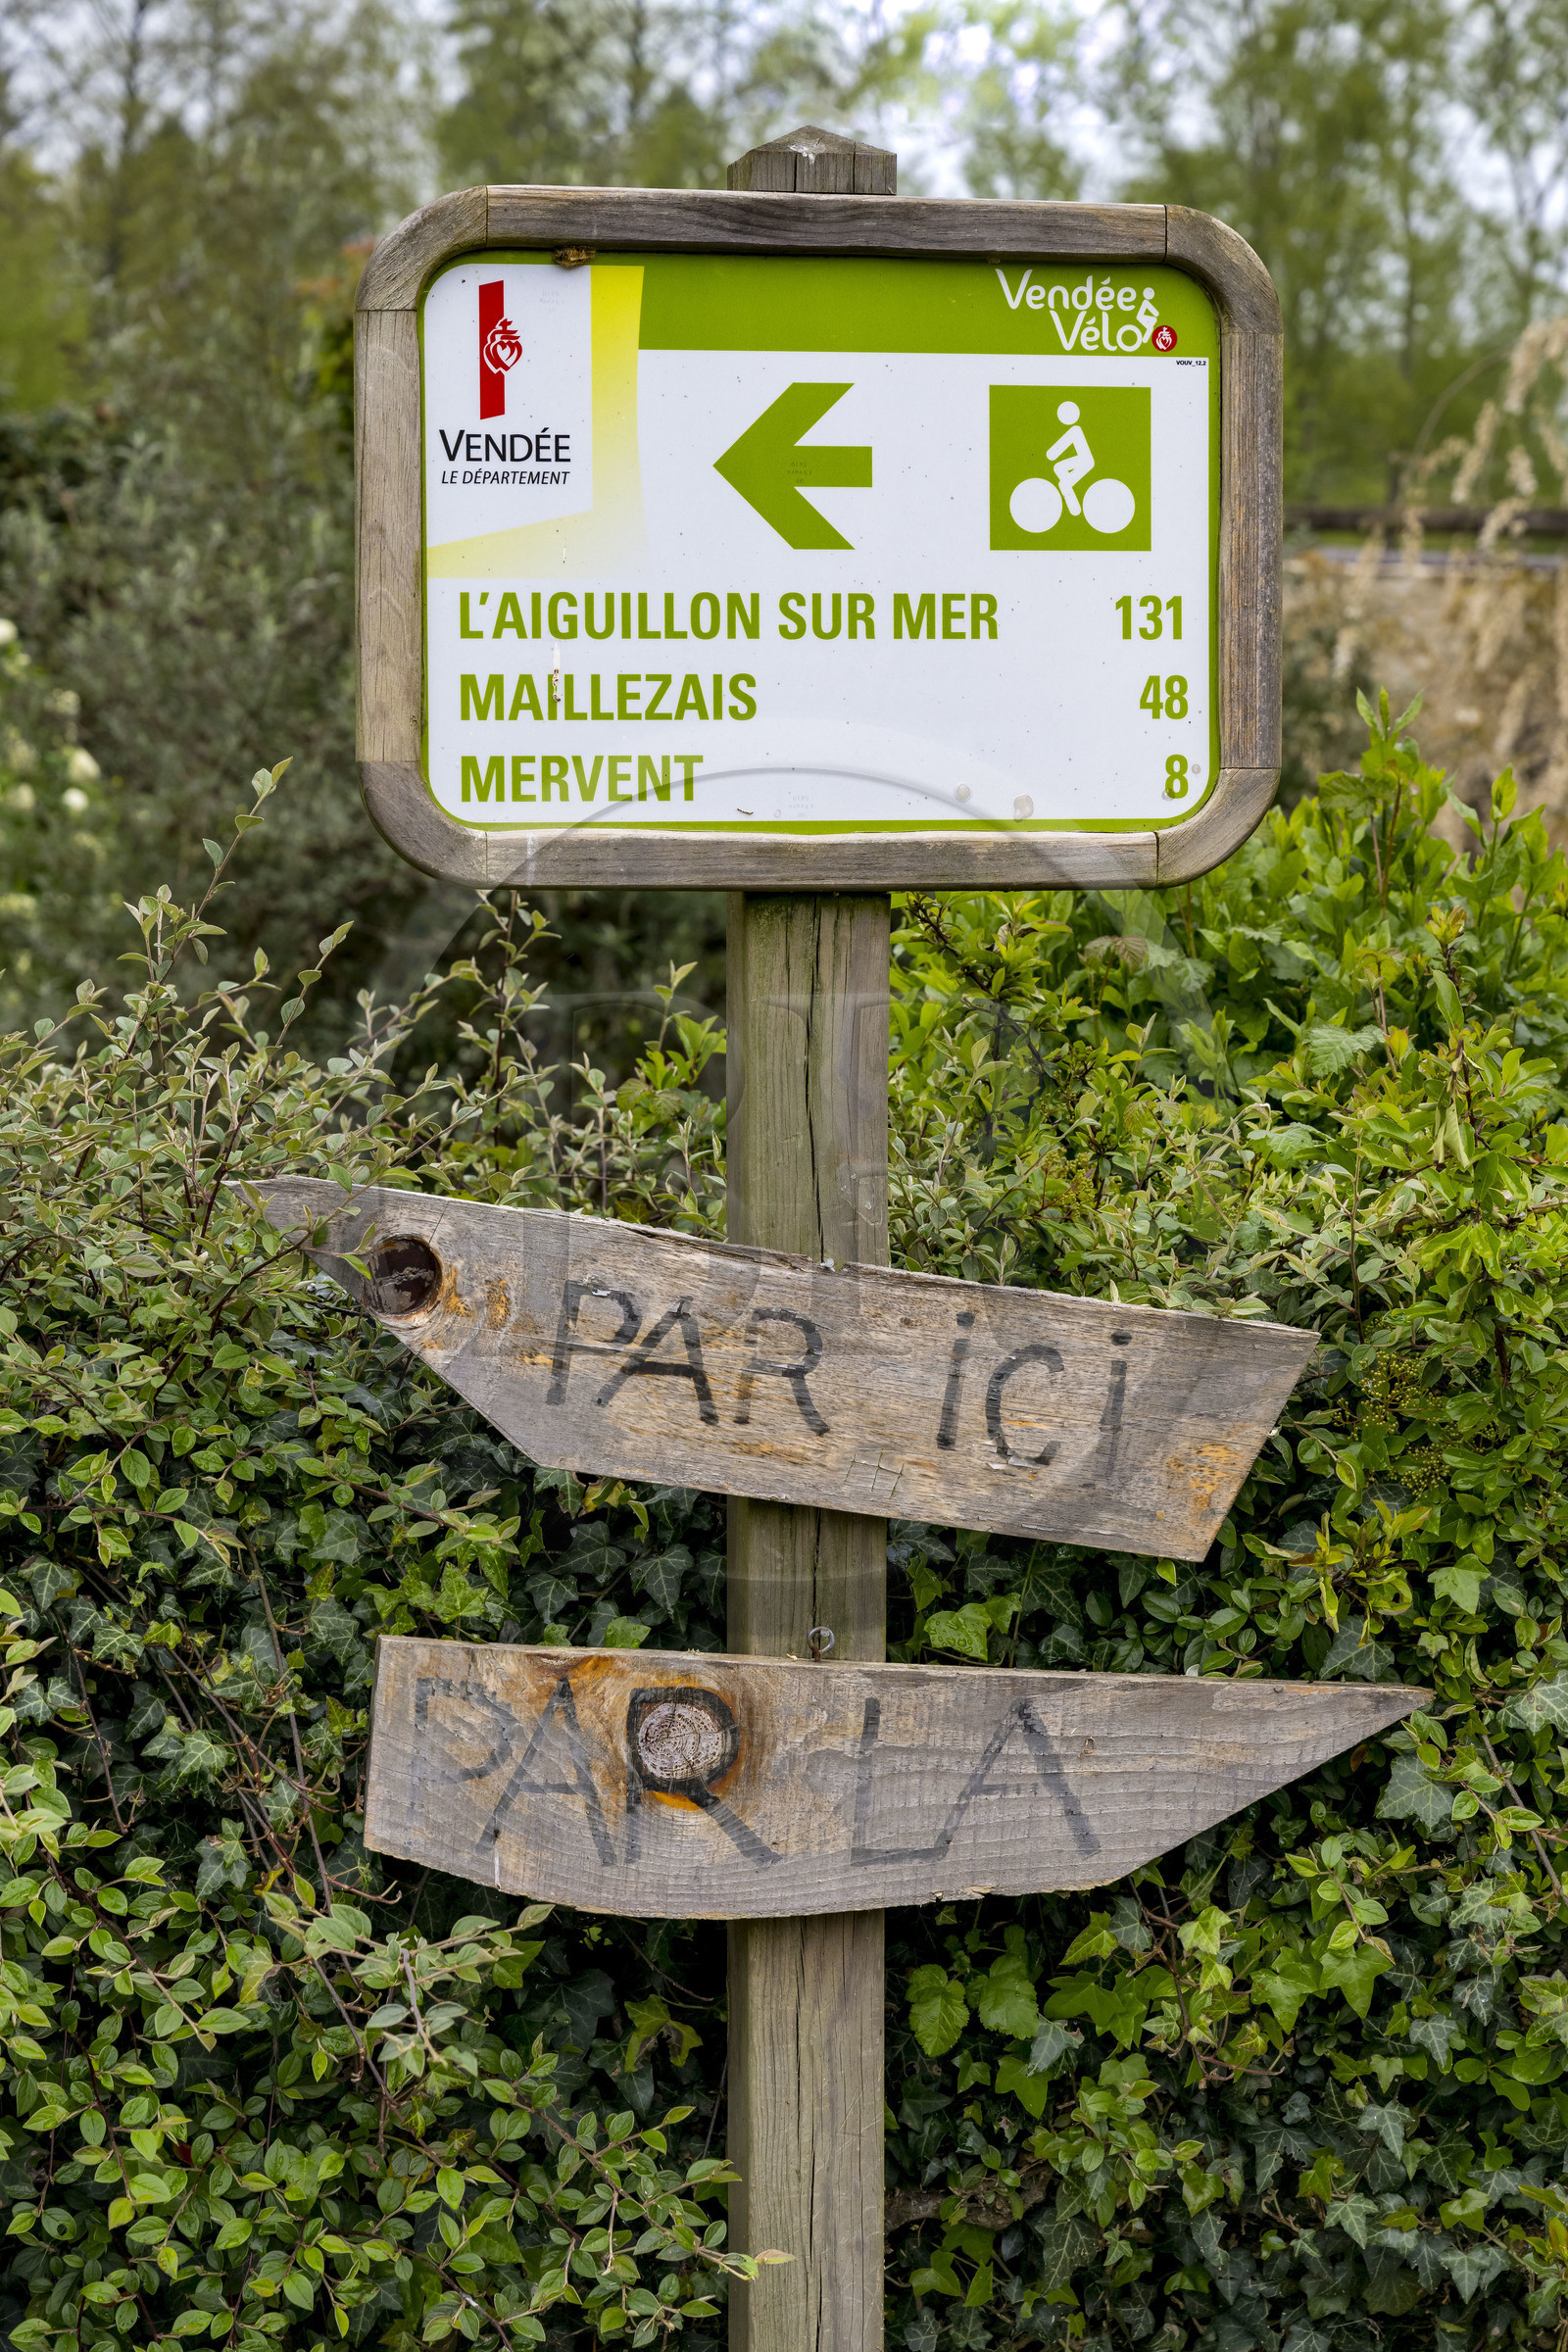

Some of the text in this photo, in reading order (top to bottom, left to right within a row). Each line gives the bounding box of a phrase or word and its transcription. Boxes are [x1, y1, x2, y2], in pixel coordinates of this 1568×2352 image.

[995, 269, 1137, 312] Vendée
[1049, 310, 1143, 352] Vélo
[438, 427, 571, 463] VENDÉE
[441, 468, 570, 485] LE DÉPARTEMENT
[459, 591, 999, 640] L'AIGUILLON SUR MER
[1114, 595, 1183, 640] 131
[460, 673, 758, 721] MAILLEZAIS
[1139, 674, 1189, 720] 48
[461, 755, 704, 803] MERVENT
[1165, 754, 1189, 800] 8
[546, 1276, 830, 1437] PAR
[407, 1677, 1102, 1866] PAR LA
